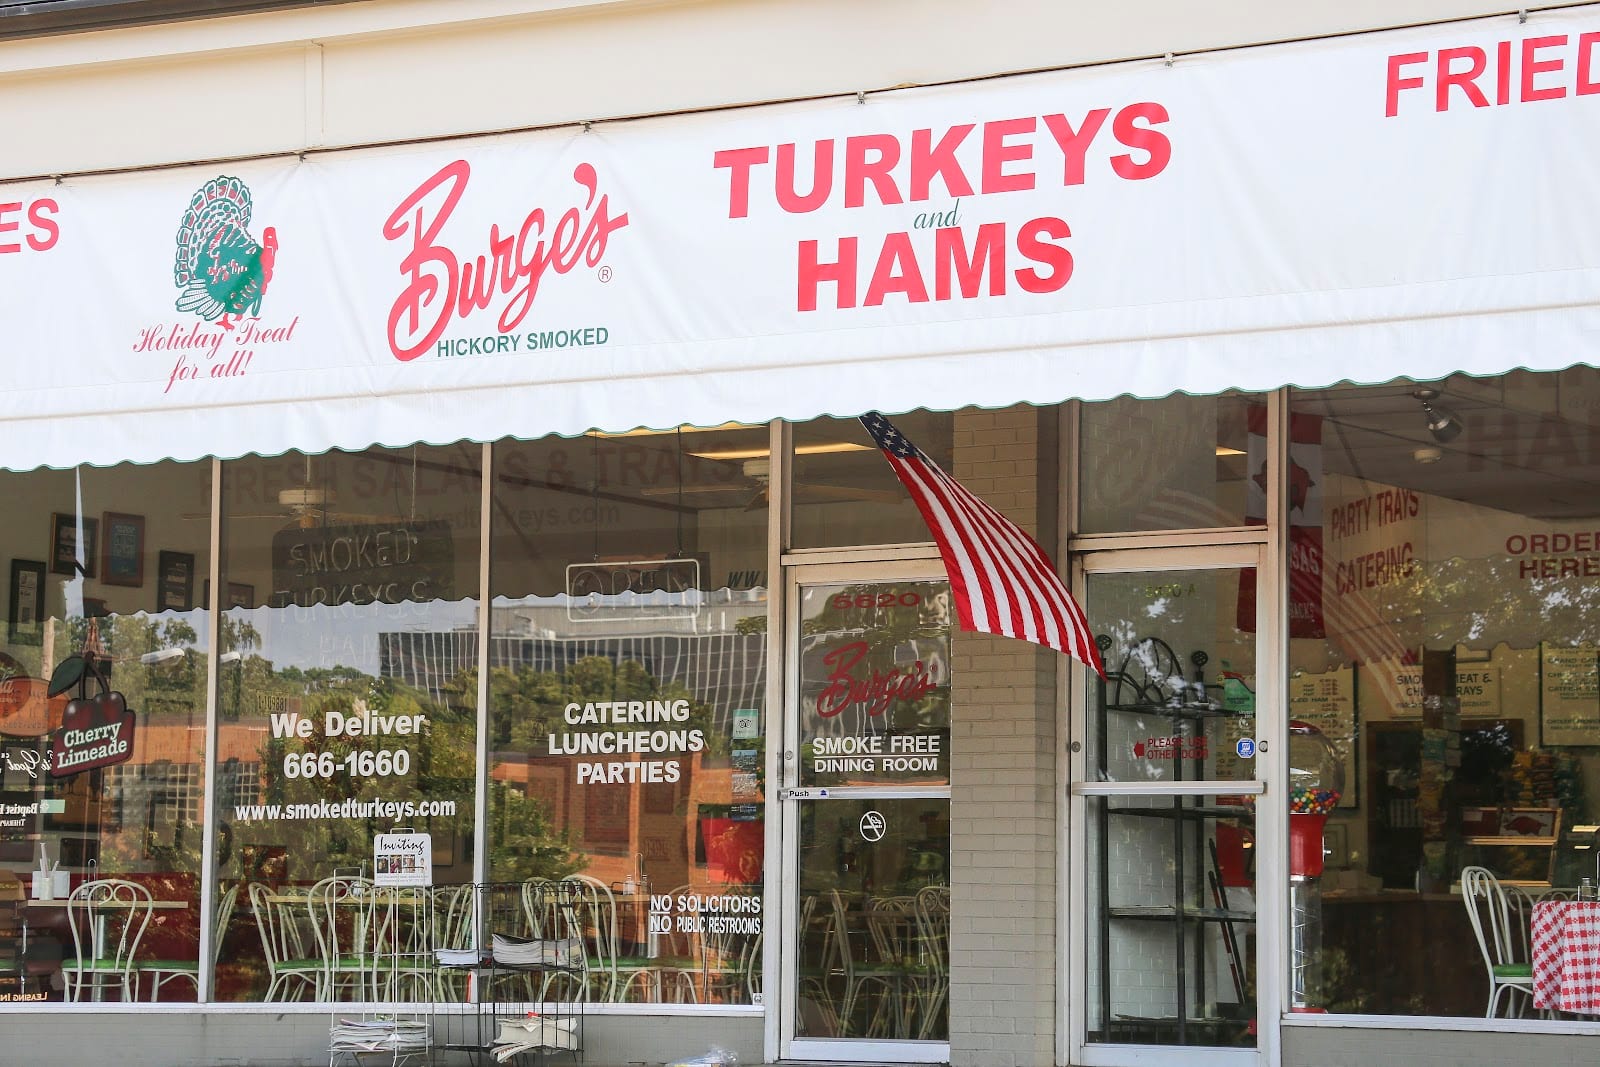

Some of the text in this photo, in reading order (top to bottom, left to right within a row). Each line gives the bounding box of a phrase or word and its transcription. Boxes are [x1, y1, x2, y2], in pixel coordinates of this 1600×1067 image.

[714, 102, 1171, 219] TURKEYS
[913, 199, 962, 231] and
[383, 160, 629, 361] Burge's
[798, 216, 1074, 312] HAMS
[133, 315, 299, 360] Holiday Treat
[438, 327, 609, 357] HICKORY SMOKED
[164, 351, 254, 394] for all!
[1331, 486, 1419, 543] PARTY TRAYS
[290, 528, 412, 576] SMOKED
[1336, 541, 1414, 595] CATERING
[1520, 557, 1600, 579] HERE
[276, 583, 406, 623] TURKEYS
[570, 565, 697, 615] OPEN
[816, 641, 937, 718] Burge's
[1455, 686, 1483, 696] RAYS
[271, 708, 425, 738] We Deliver
[564, 700, 690, 725] CATERING
[64, 722, 122, 749] Cherry
[549, 729, 703, 755] LUNCHEONS
[812, 735, 940, 755] SMOKE FREE
[1147, 736, 1208, 748] PLEASE USE
[57, 739, 128, 769] Limeade
[284, 749, 410, 779] 666-1660
[814, 757, 938, 773] DINING ROOM
[1147, 747, 1209, 761] OTHER DOOR
[577, 761, 681, 785] PARTIES
[788, 789, 810, 798] Push
[236, 798, 456, 822] www.smokedturkeys.com
[380, 835, 425, 856] Inviting
[650, 895, 761, 914] NO SOLICITORS
[649, 915, 761, 935] NO PUBLIC RESTROOMS
